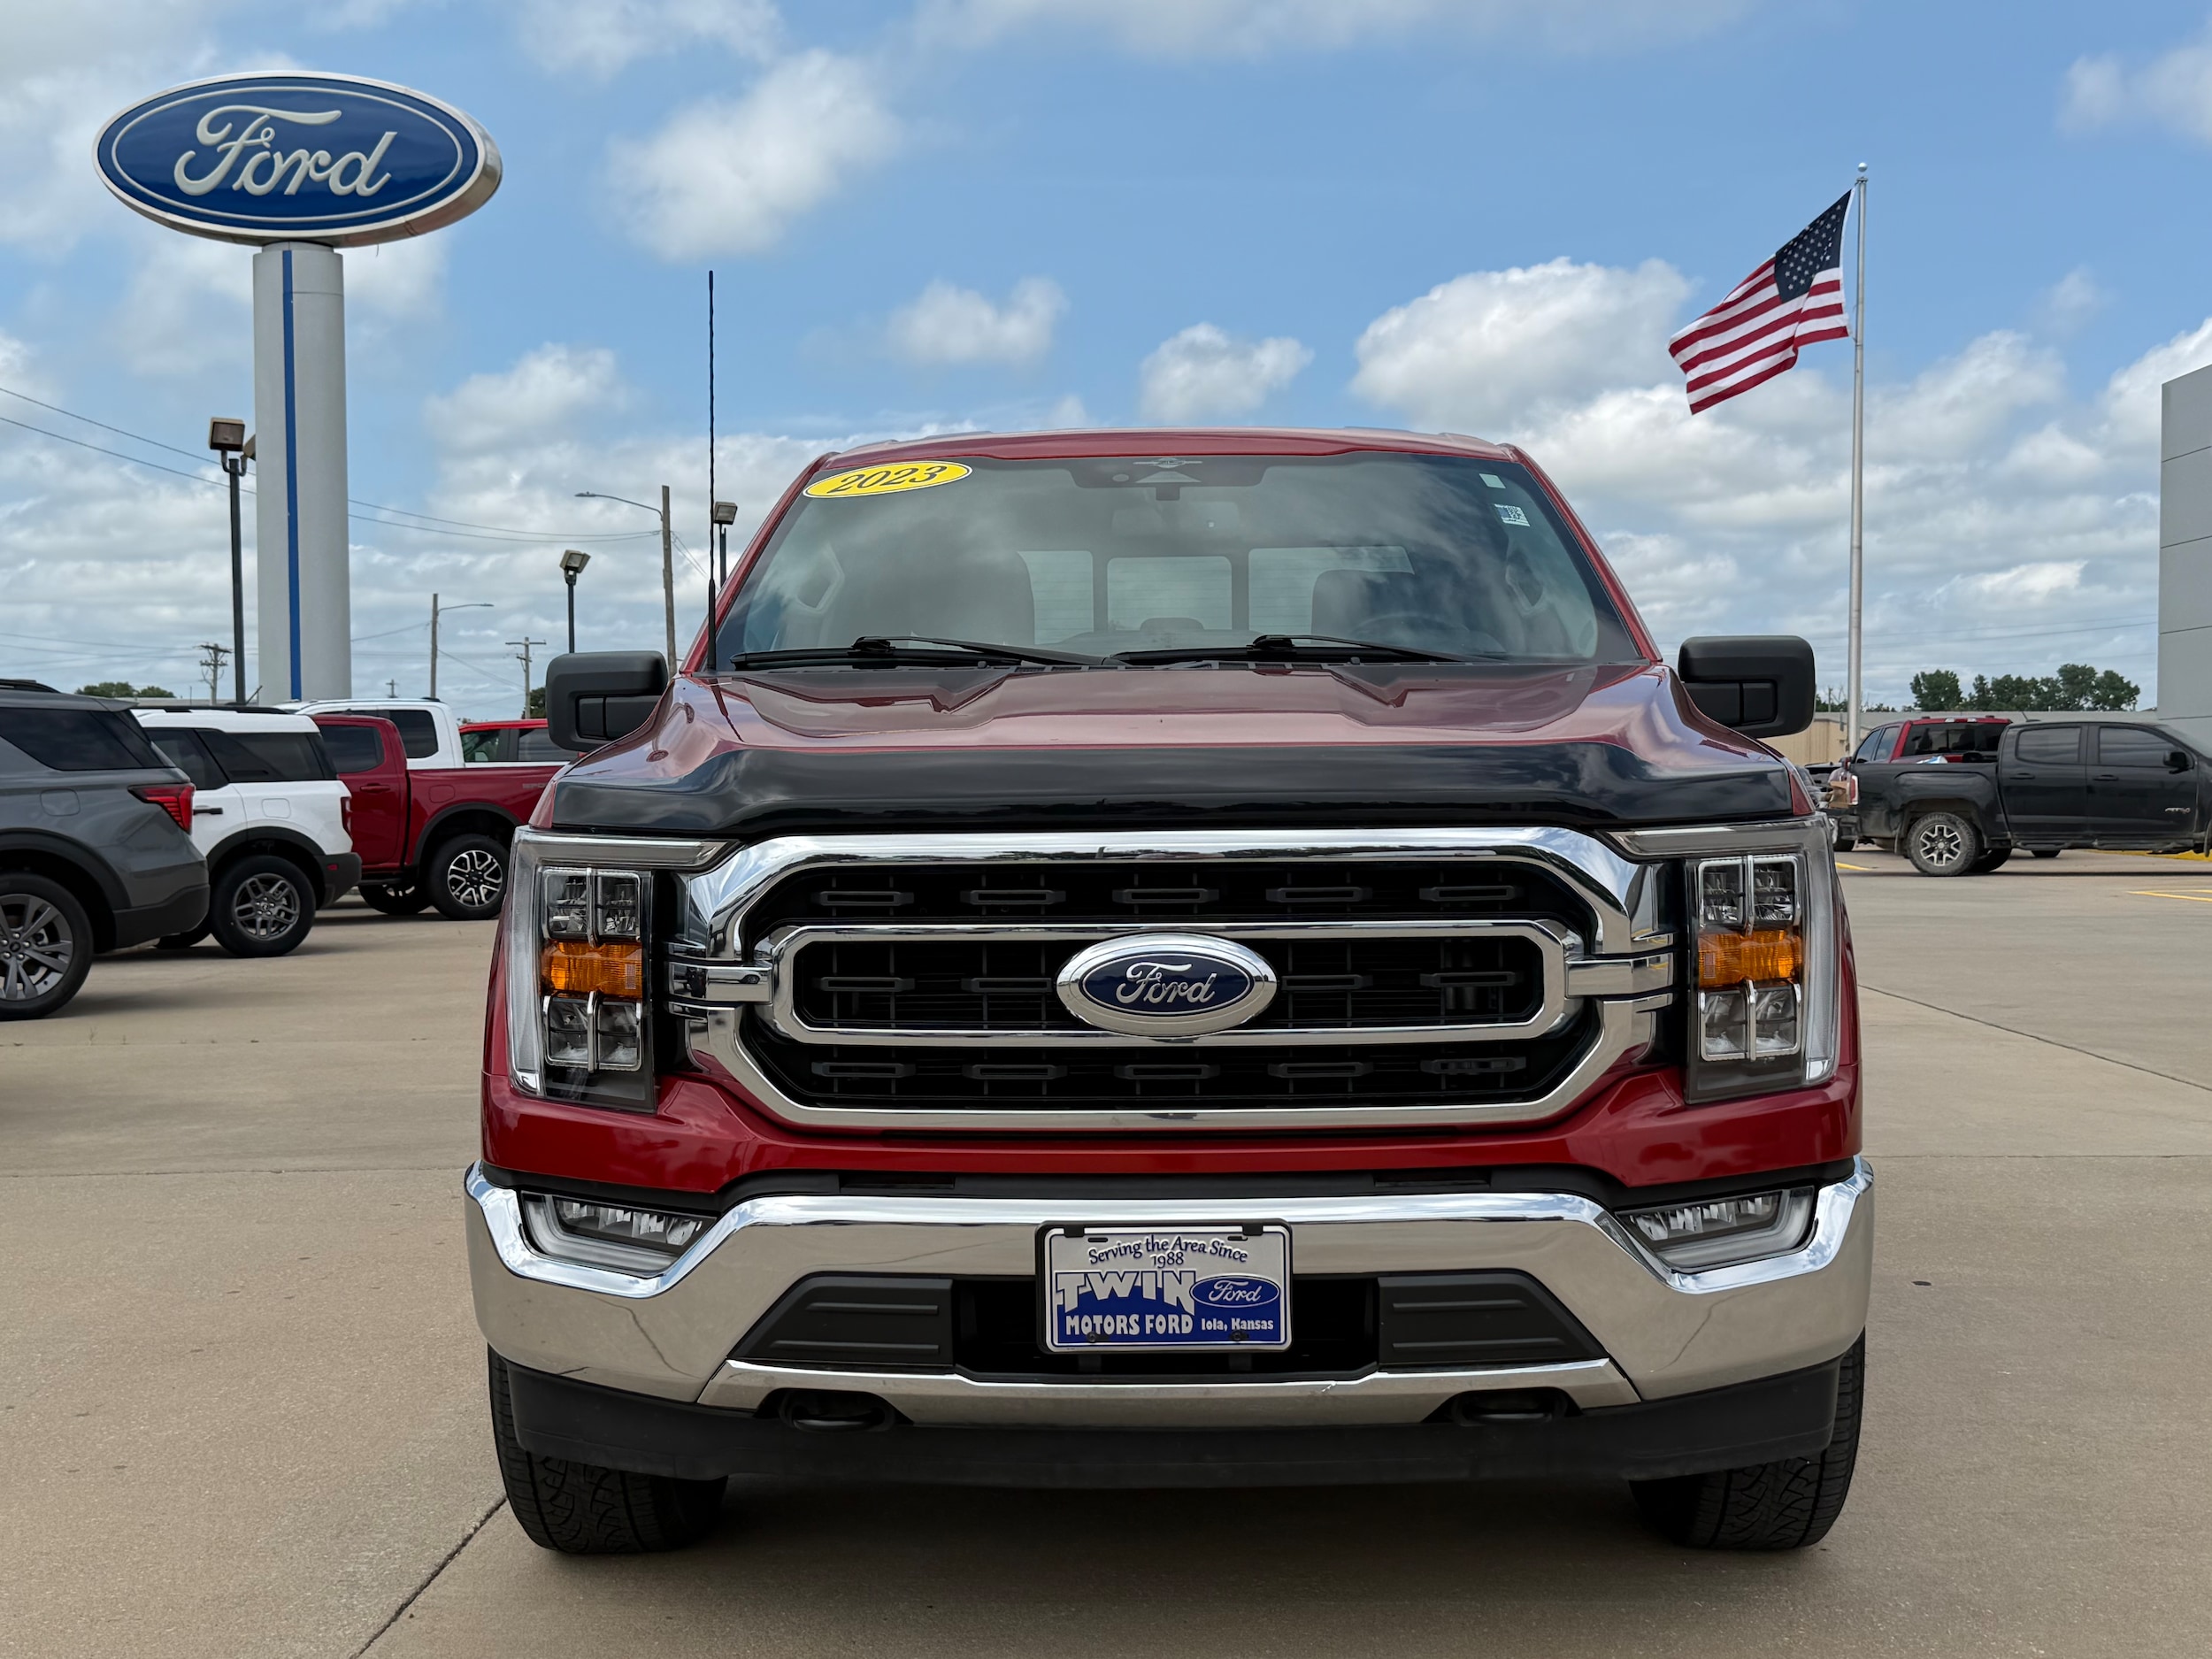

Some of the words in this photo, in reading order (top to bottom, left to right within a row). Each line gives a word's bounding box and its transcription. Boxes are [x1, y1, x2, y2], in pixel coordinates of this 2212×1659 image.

[173, 104, 397, 196] Ford
[826, 465, 948, 494] 2023
[1116, 961, 1217, 1004] Ford
[1088, 1241, 1143, 1264] Serving
[1146, 1234, 1169, 1252] the
[1170, 1236, 1207, 1253] Area
[1209, 1240, 1248, 1263] Since
[1151, 1251, 1184, 1269] 1988
[1056, 1271, 1196, 1317] TWIN
[1208, 1279, 1262, 1302] Ford
[1065, 1314, 1140, 1335] MOTORS
[1145, 1314, 1194, 1335] FORD
[1201, 1317, 1228, 1332] Iola,
[1231, 1317, 1274, 1331] Kansas
